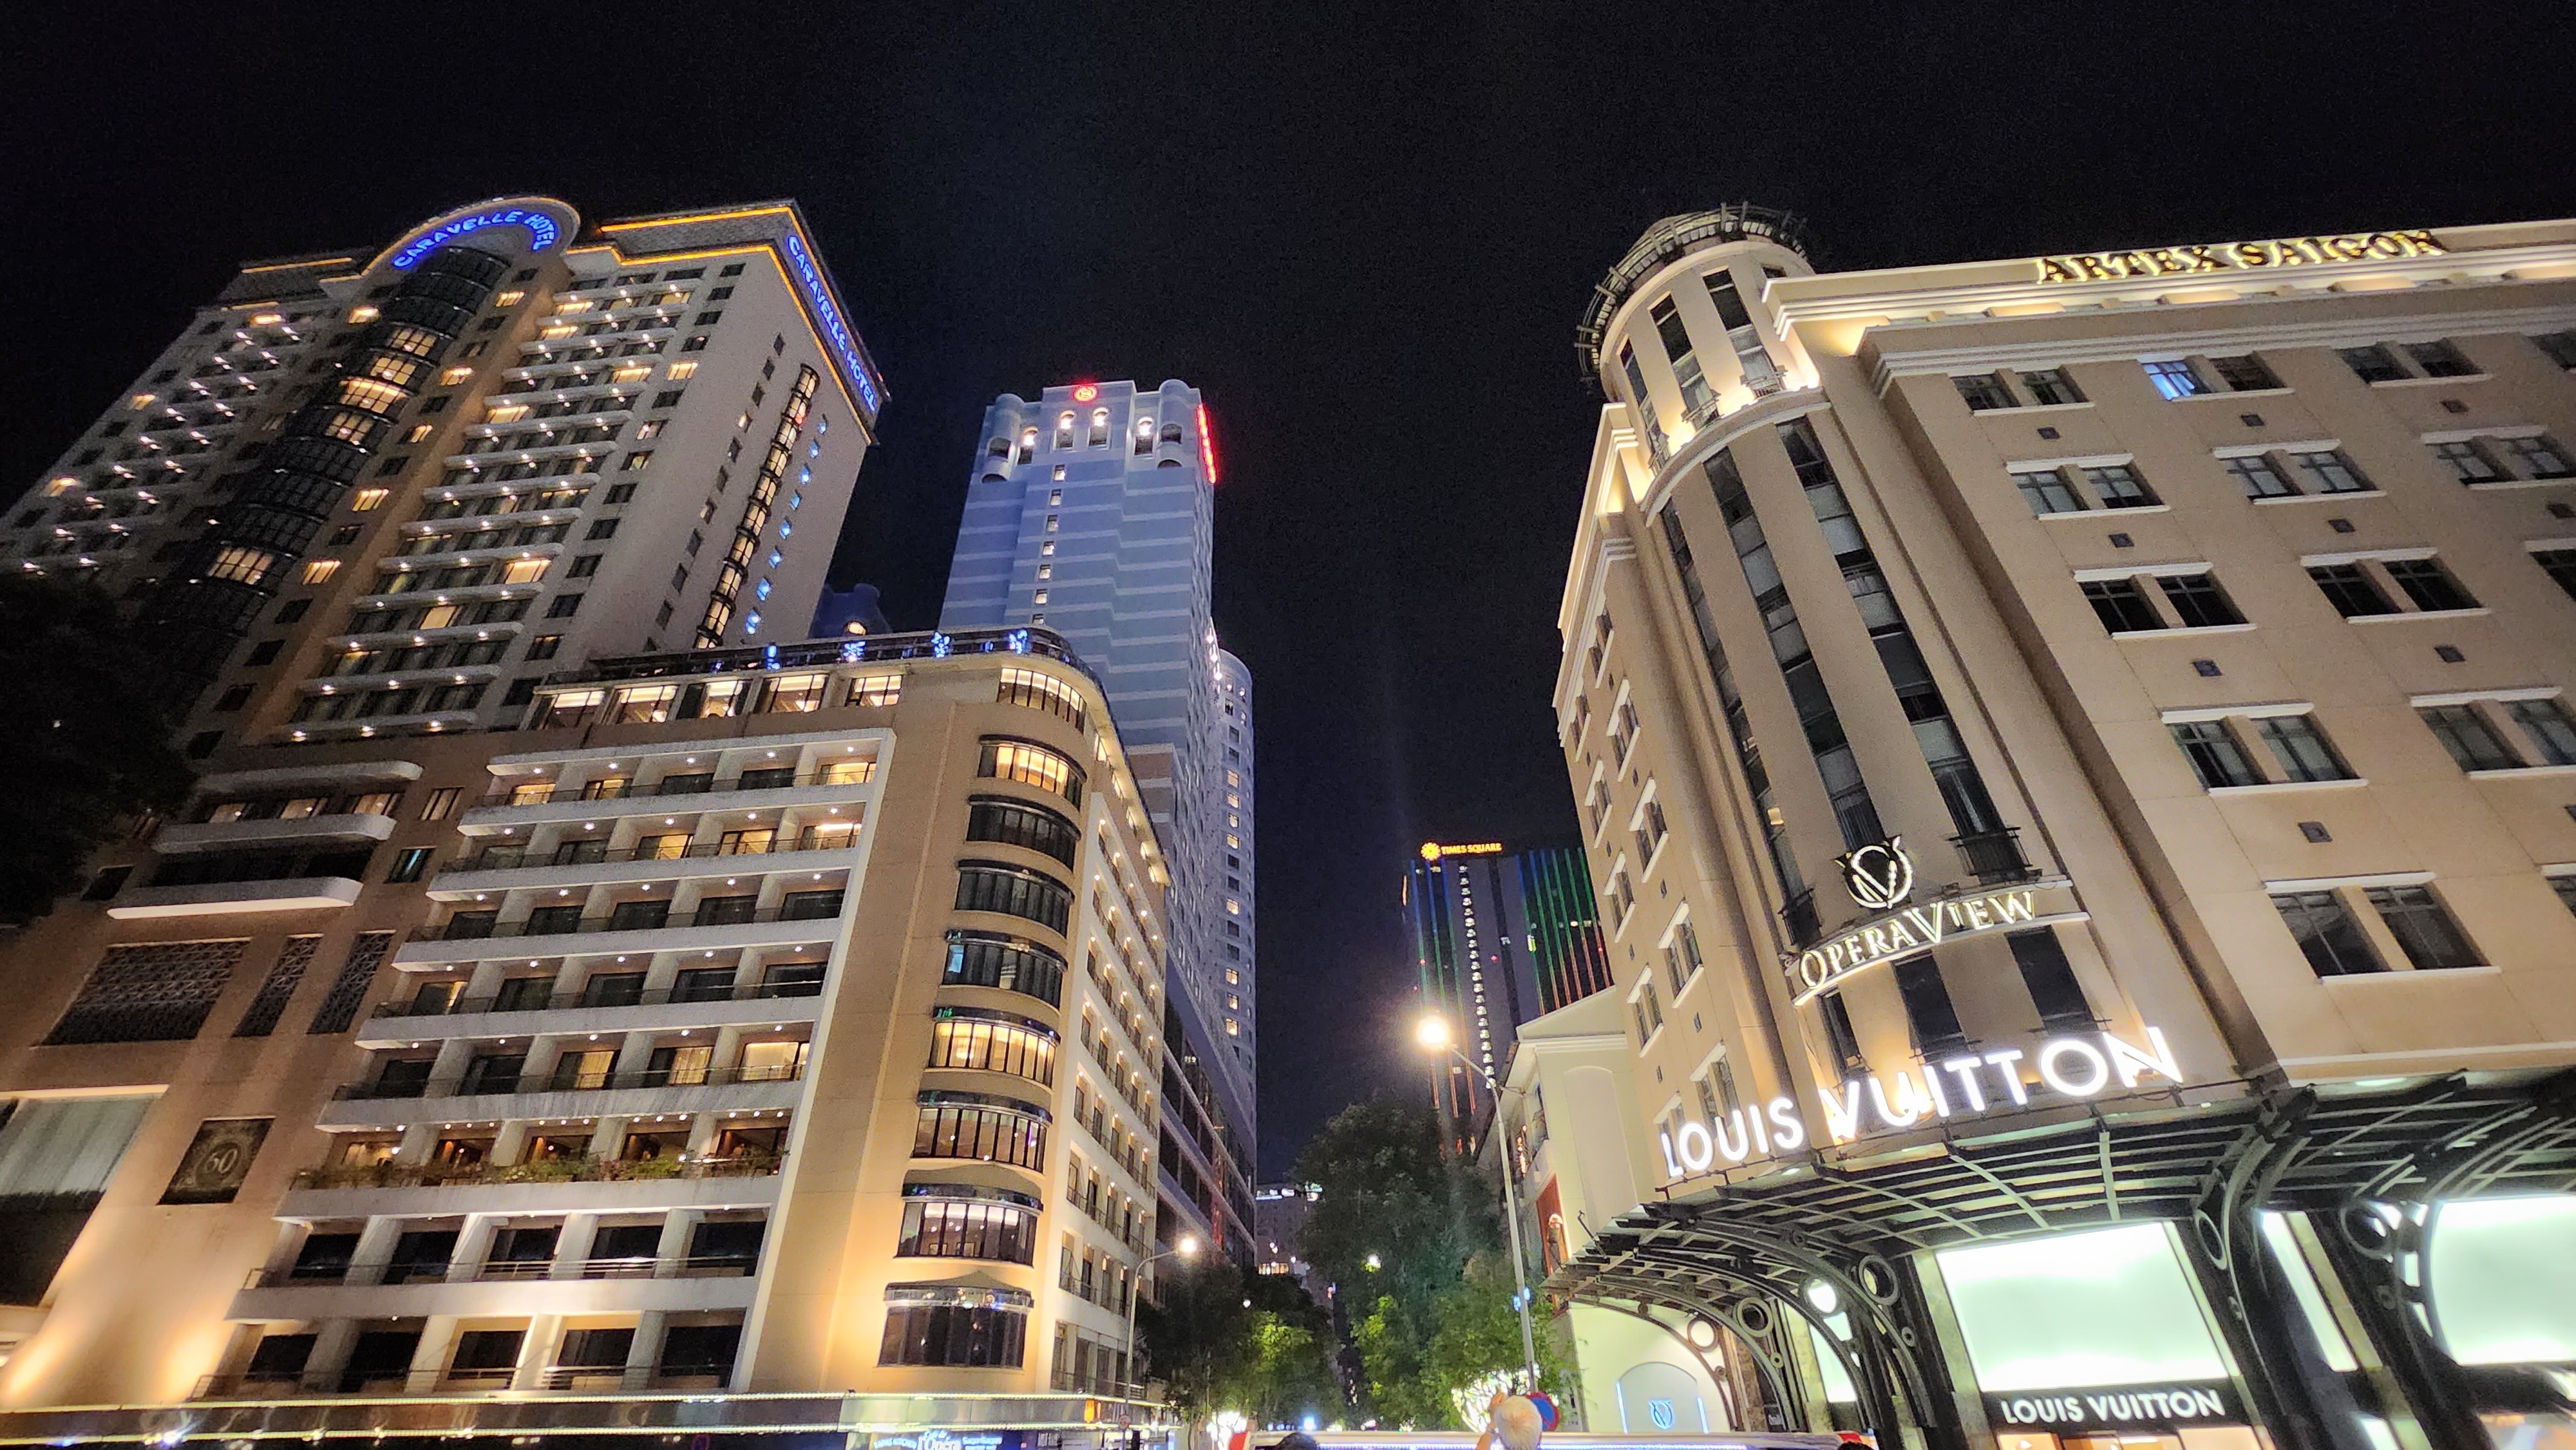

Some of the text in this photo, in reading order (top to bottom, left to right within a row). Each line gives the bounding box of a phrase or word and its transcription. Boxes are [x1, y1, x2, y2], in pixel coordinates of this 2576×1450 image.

[392, 209, 556, 268] CARAVELLE HOTEL
[2035, 229, 2448, 285] ARTEX SAIGON
[788, 235, 876, 412] CARAVELLE HOTEL
[1442, 843, 1502, 855] TIMES SQUARE
[1660, 1026, 2184, 1178] LOUIS VUITTON
[2000, 1388, 2226, 1424] LOUIS VUITTON
